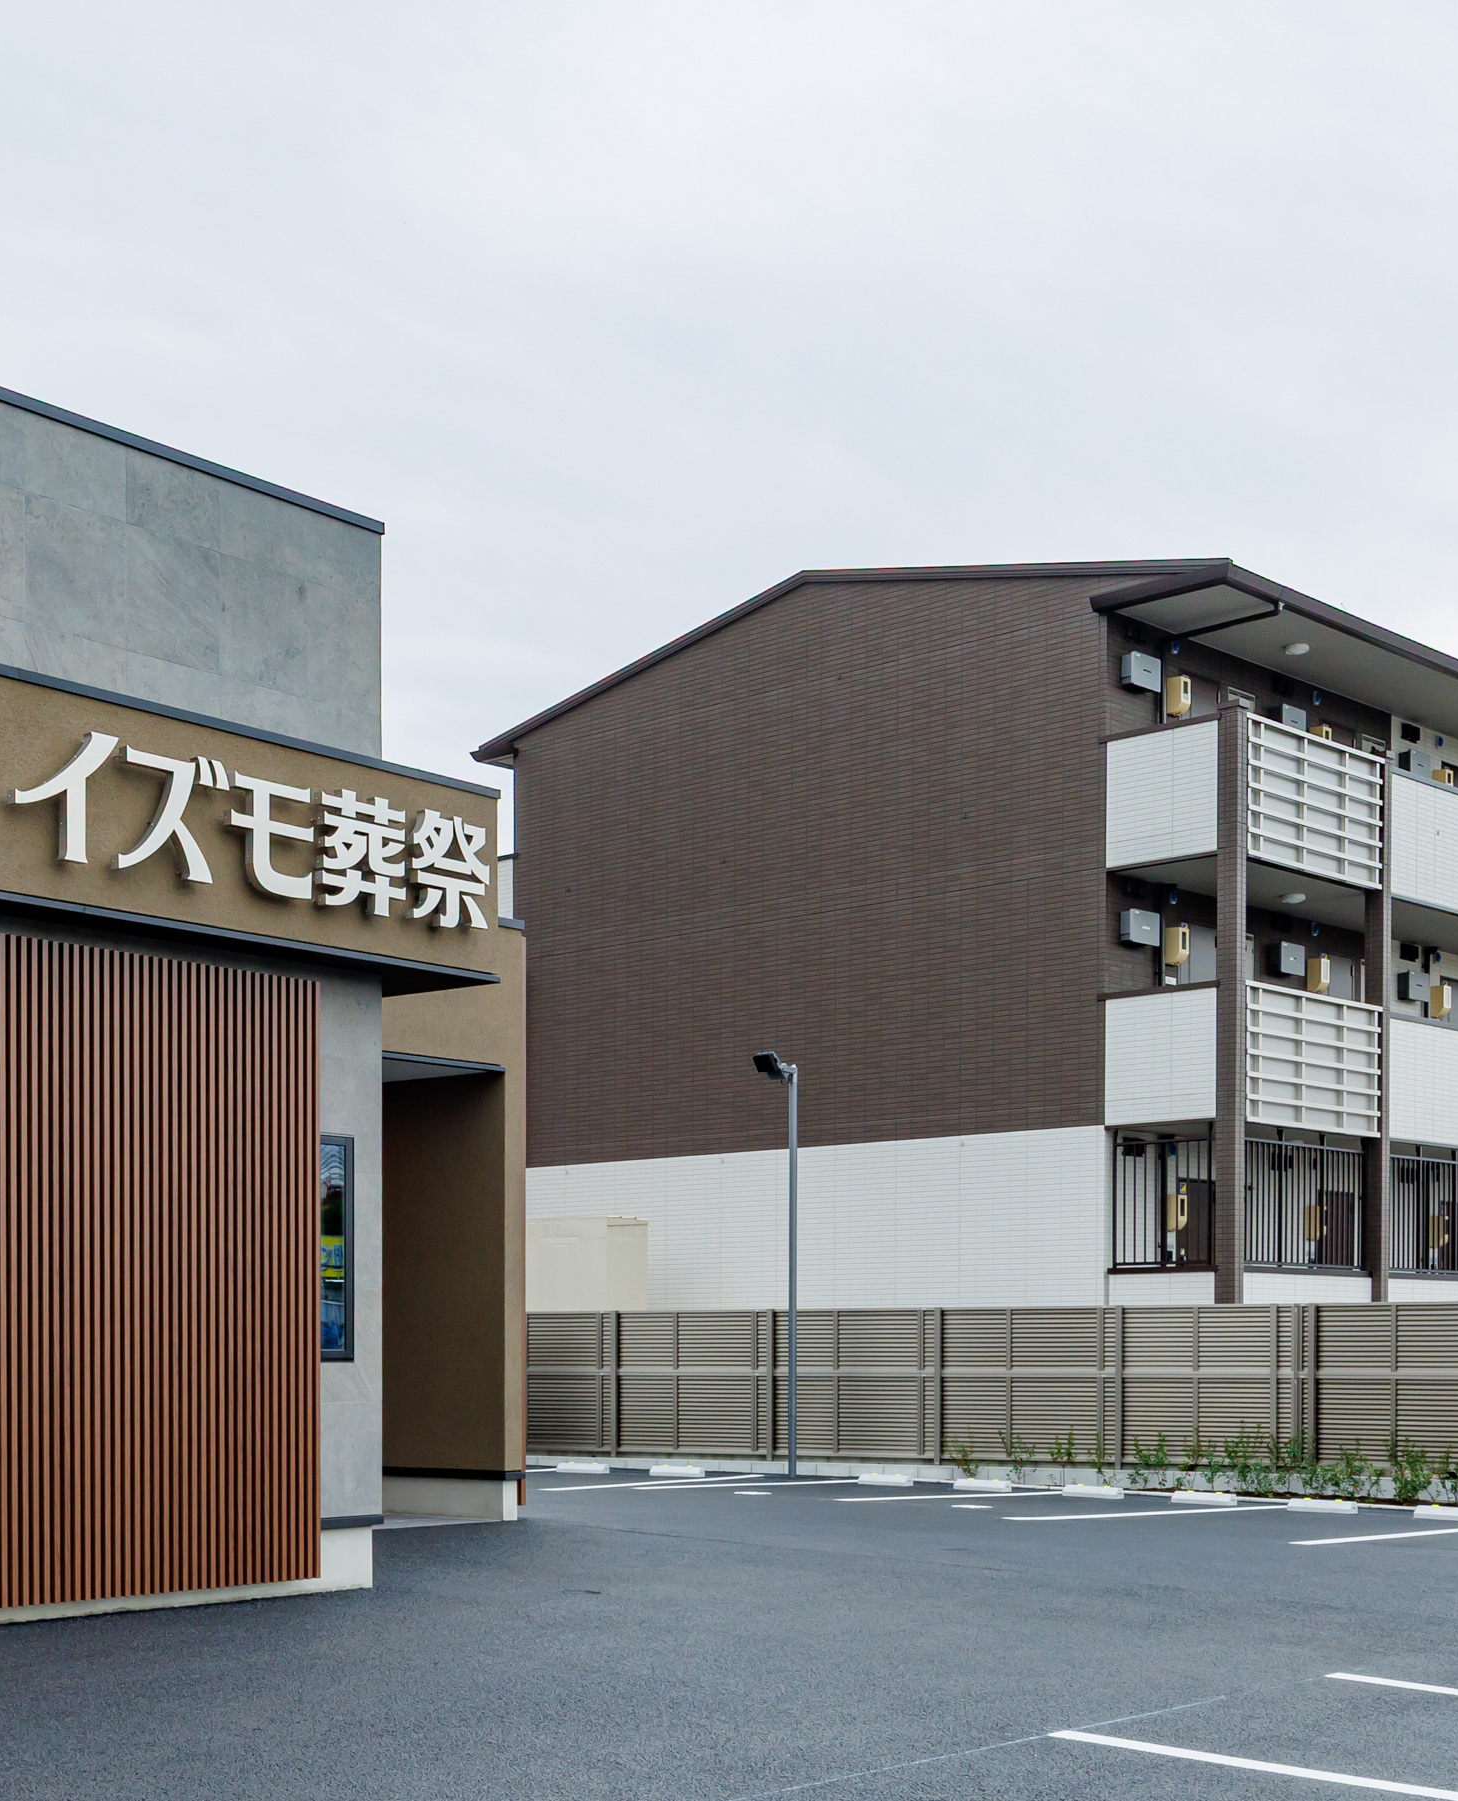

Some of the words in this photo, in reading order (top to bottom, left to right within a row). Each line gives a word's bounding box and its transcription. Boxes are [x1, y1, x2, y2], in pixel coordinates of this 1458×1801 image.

[6, 731, 491, 930] イズモ葬祭
